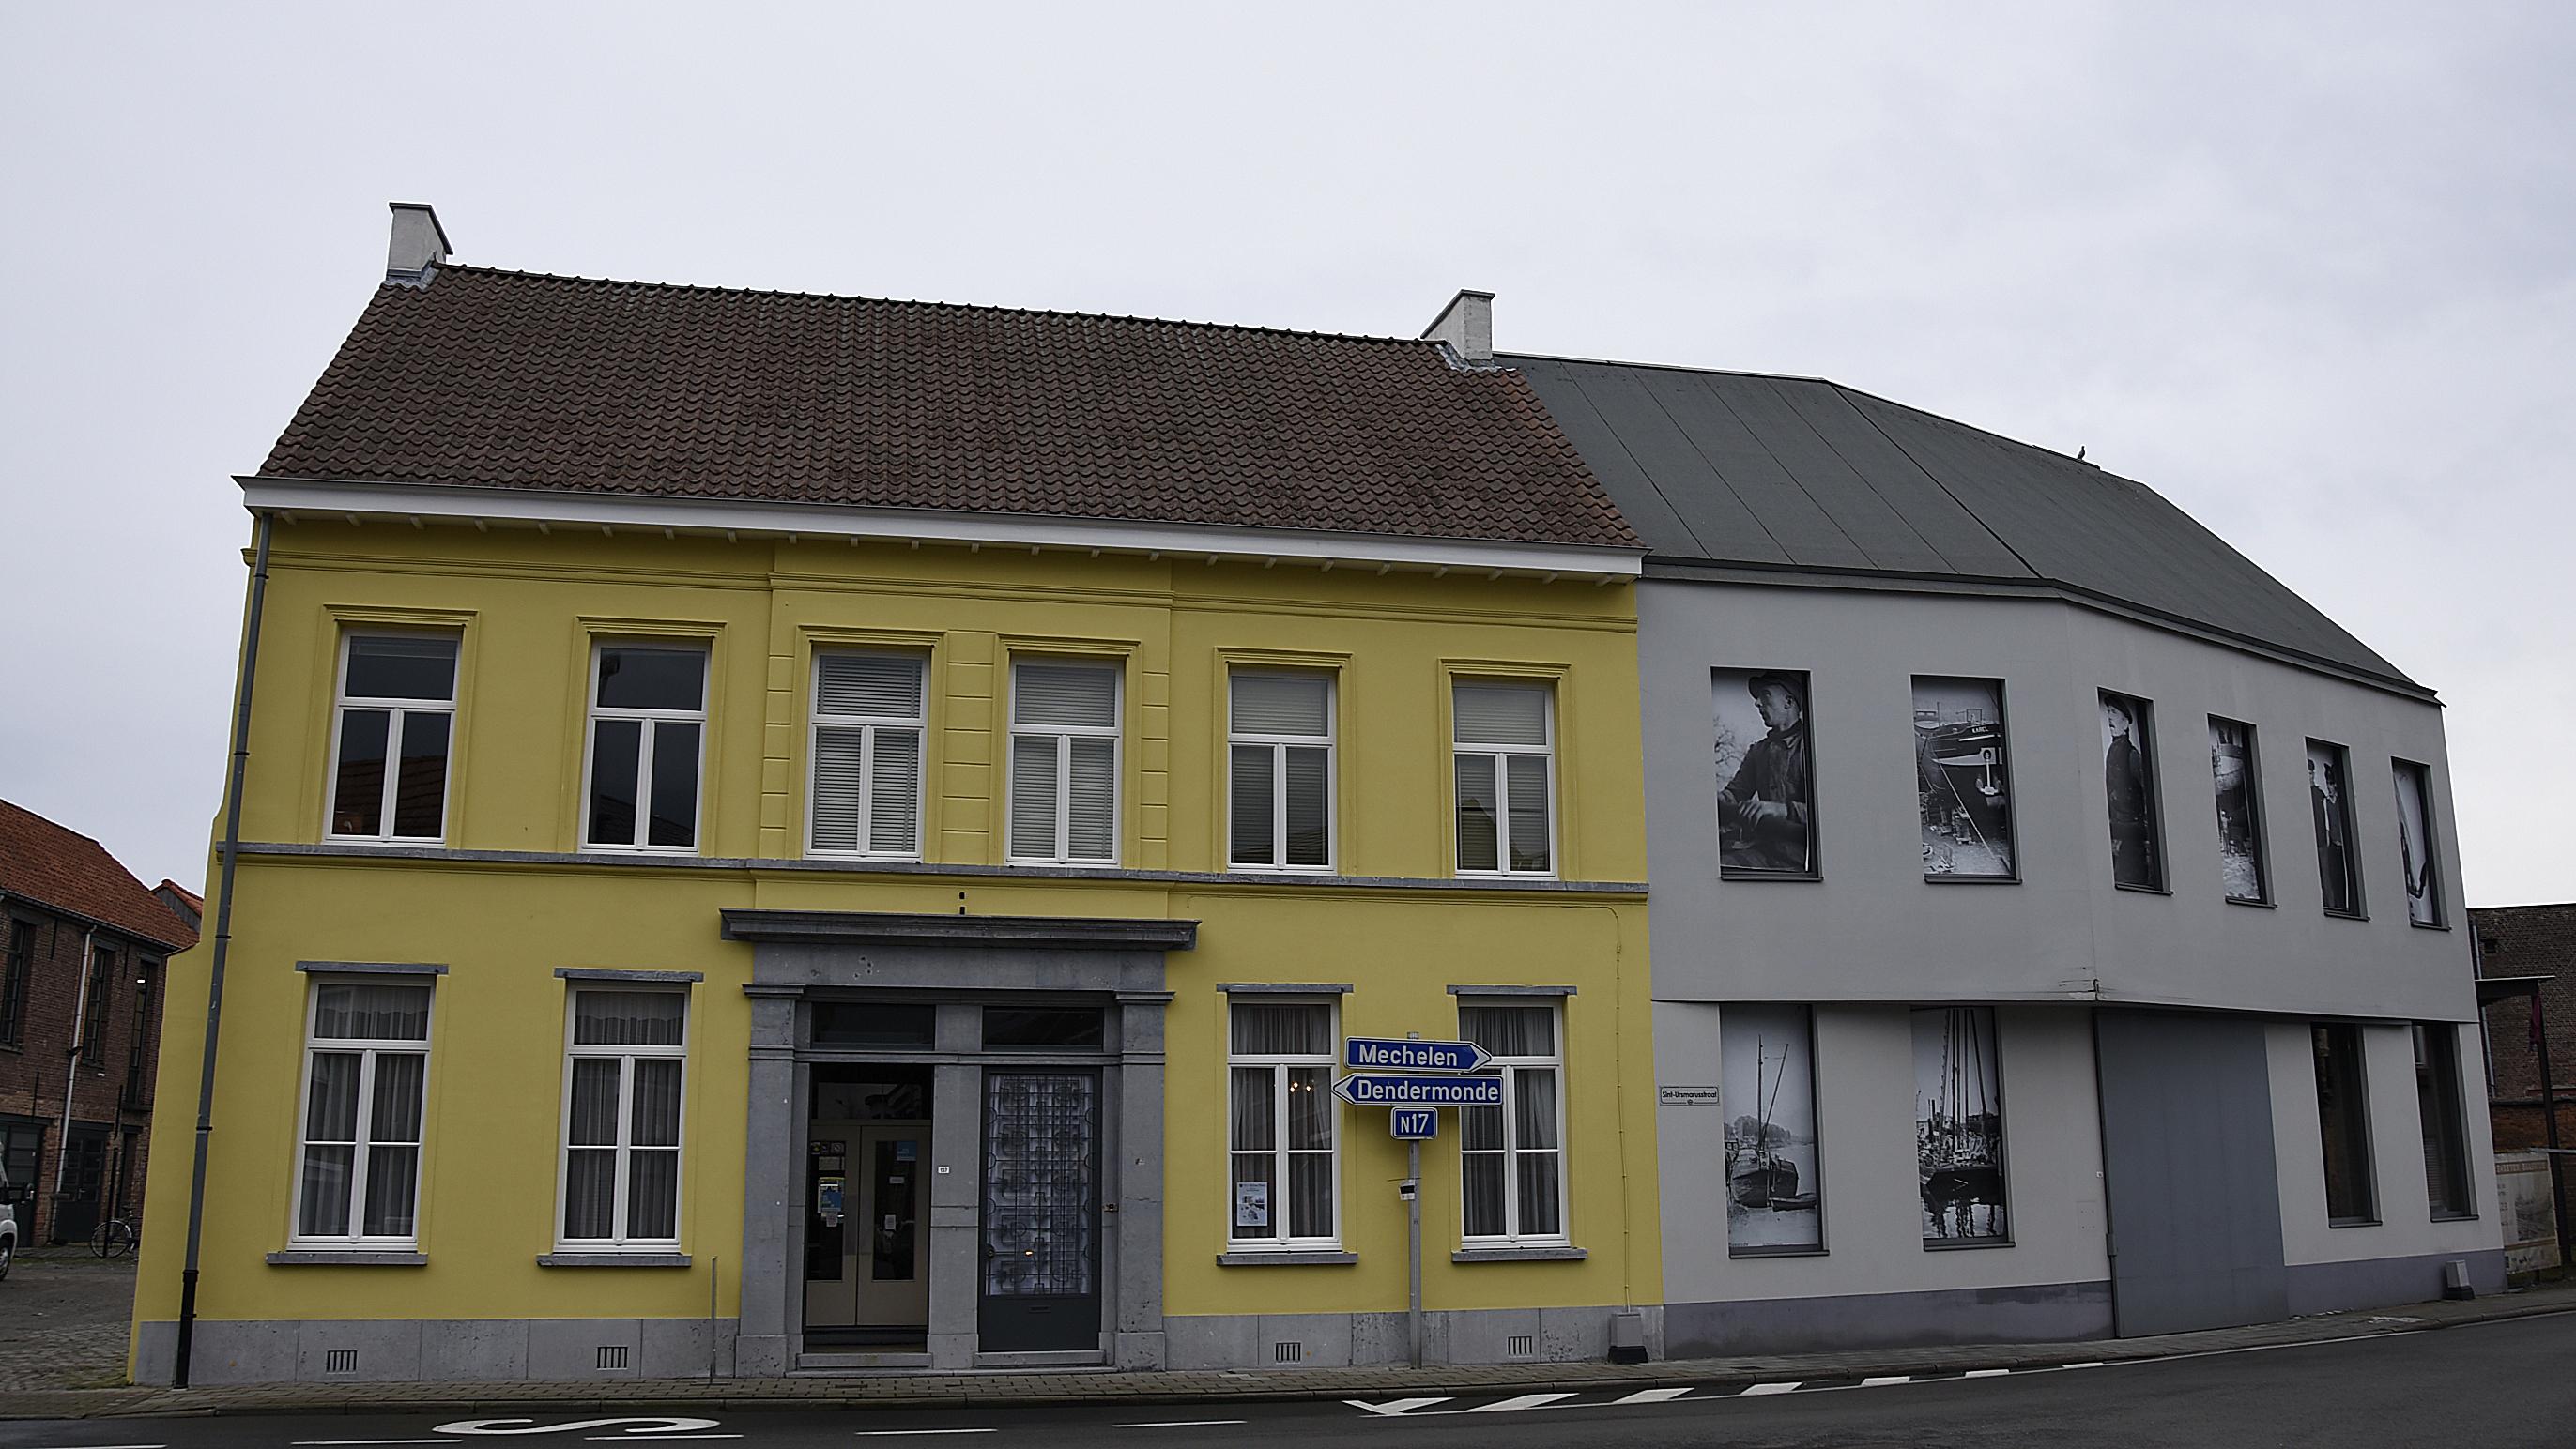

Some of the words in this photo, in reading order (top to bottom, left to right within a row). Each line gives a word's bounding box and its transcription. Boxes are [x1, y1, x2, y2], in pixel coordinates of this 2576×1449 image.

[1358, 1044, 1458, 1067] Mechelen
[1357, 1079, 1499, 1102] Dendermonde
[1400, 1113, 1429, 1134] N17
